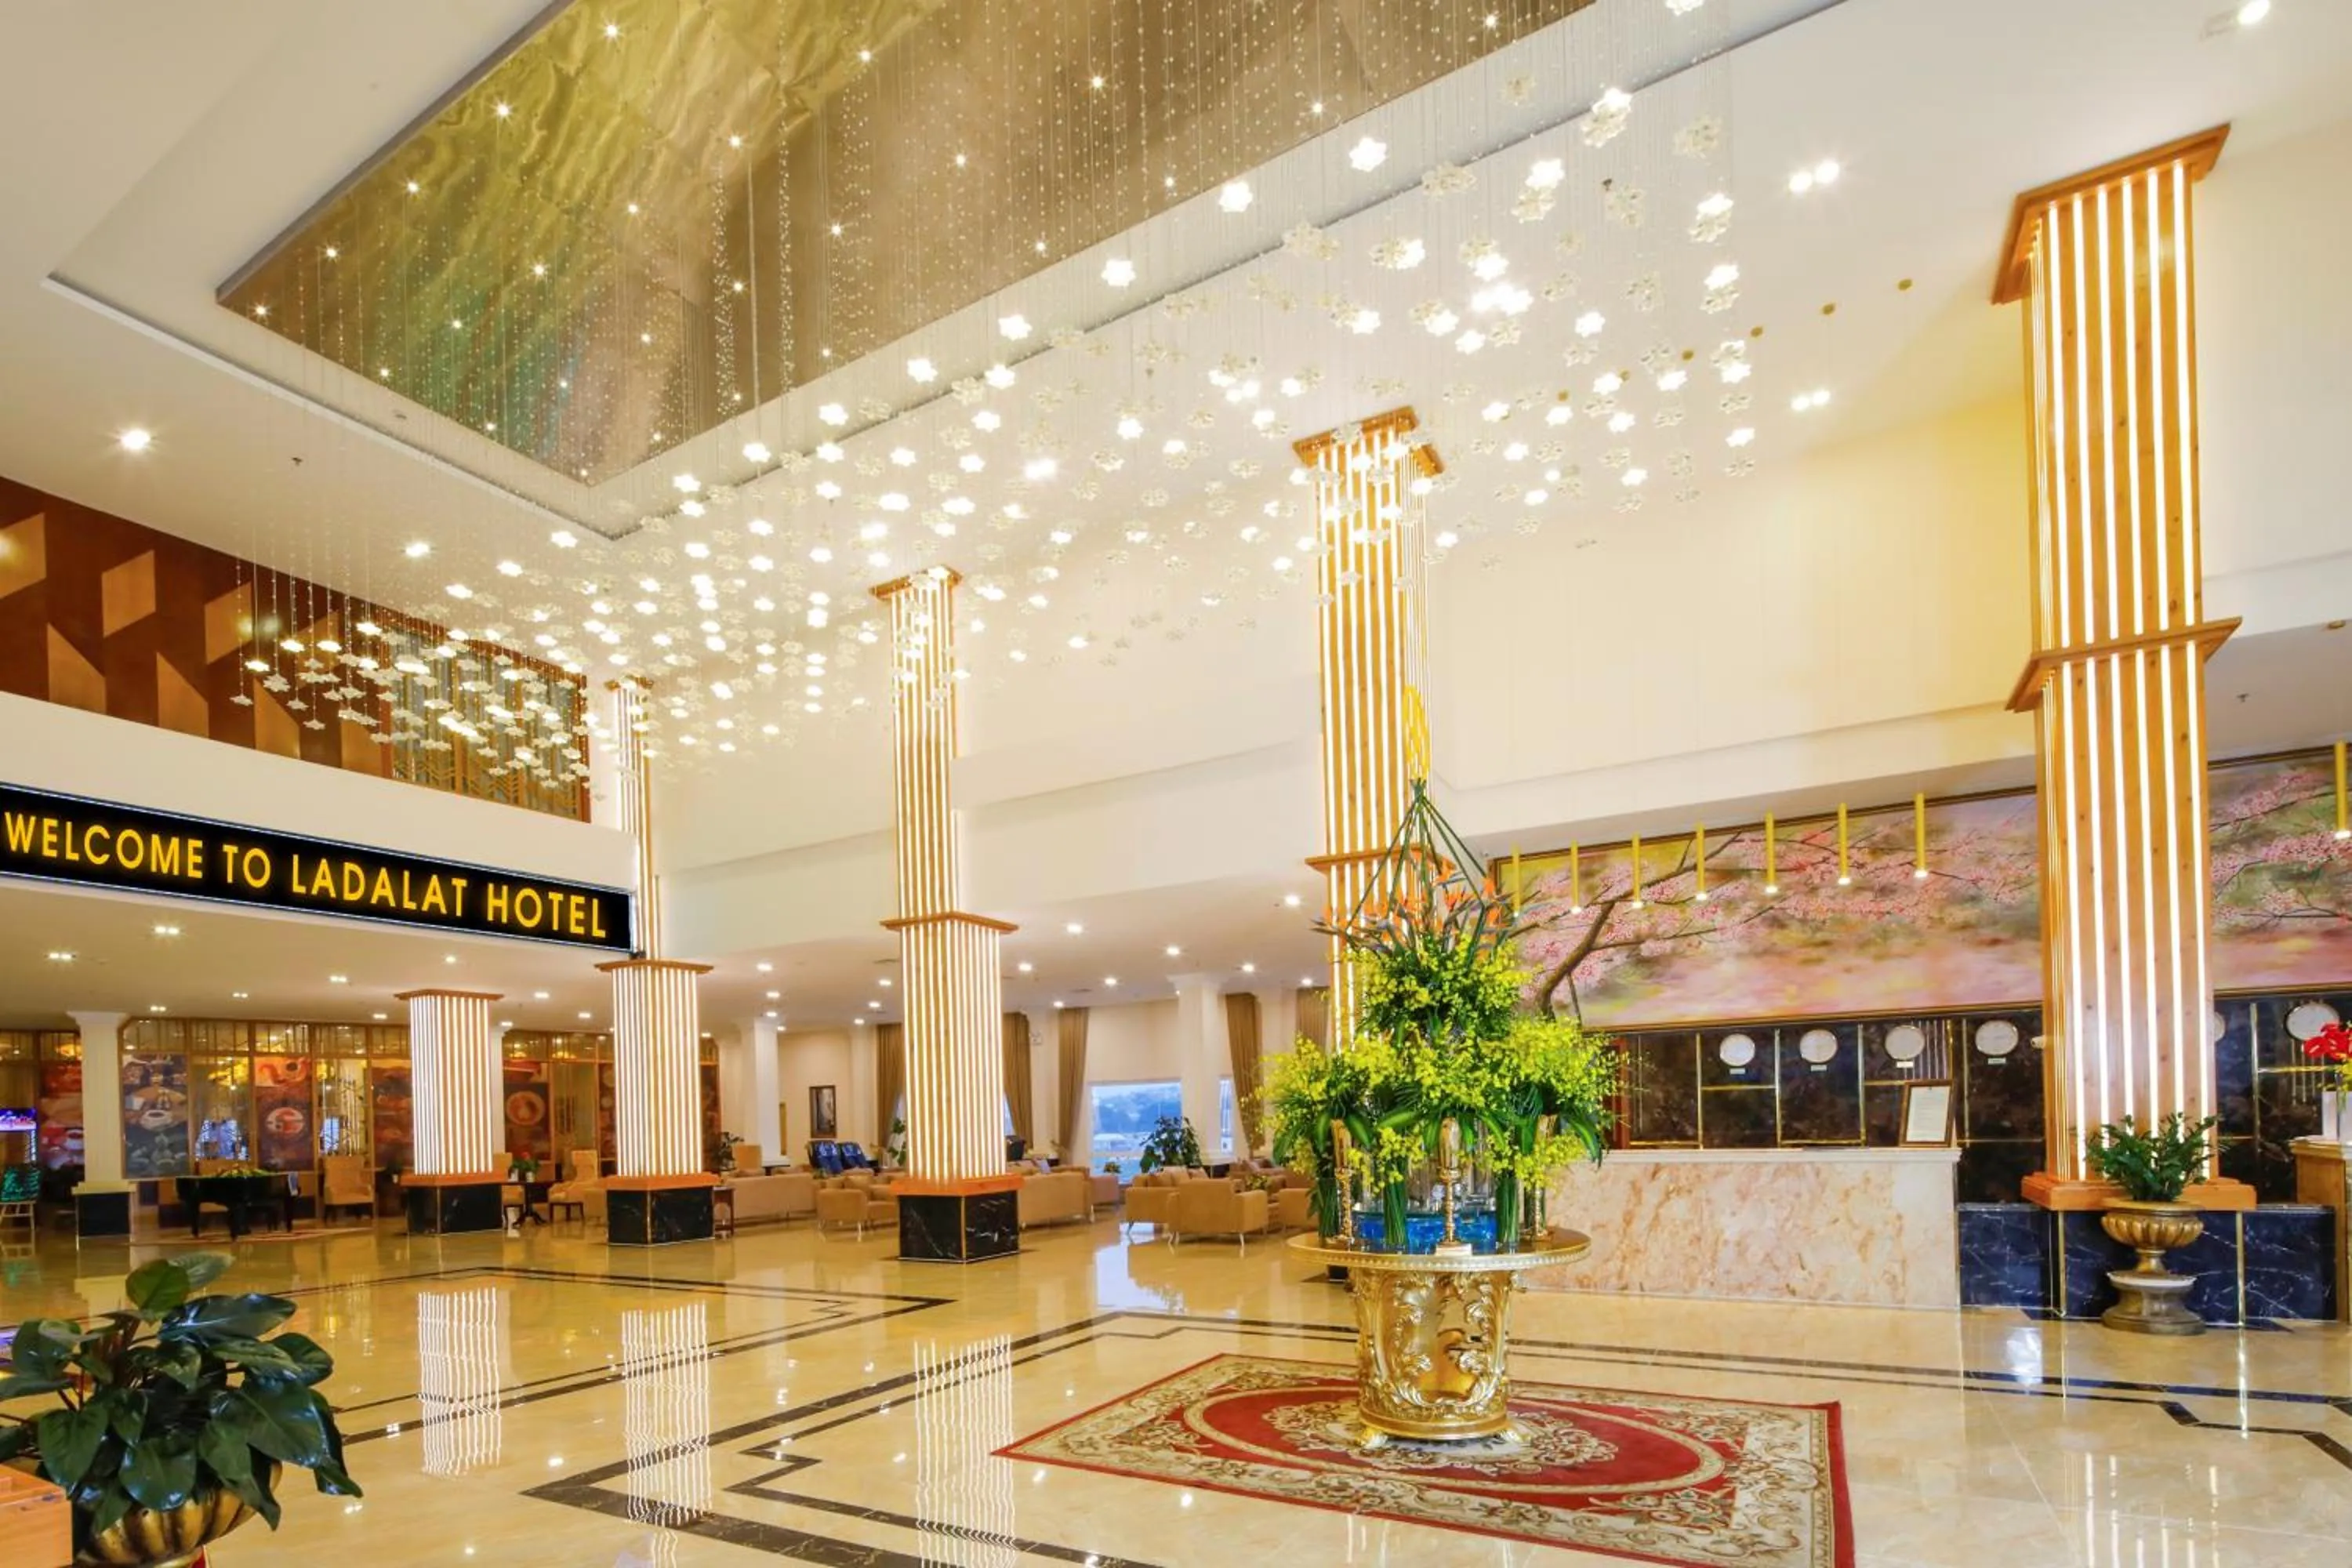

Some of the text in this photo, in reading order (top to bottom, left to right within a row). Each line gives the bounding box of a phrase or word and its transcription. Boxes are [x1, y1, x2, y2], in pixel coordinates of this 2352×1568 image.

[5, 811, 606, 938] WELCOME TO LADALAT HOTEL
